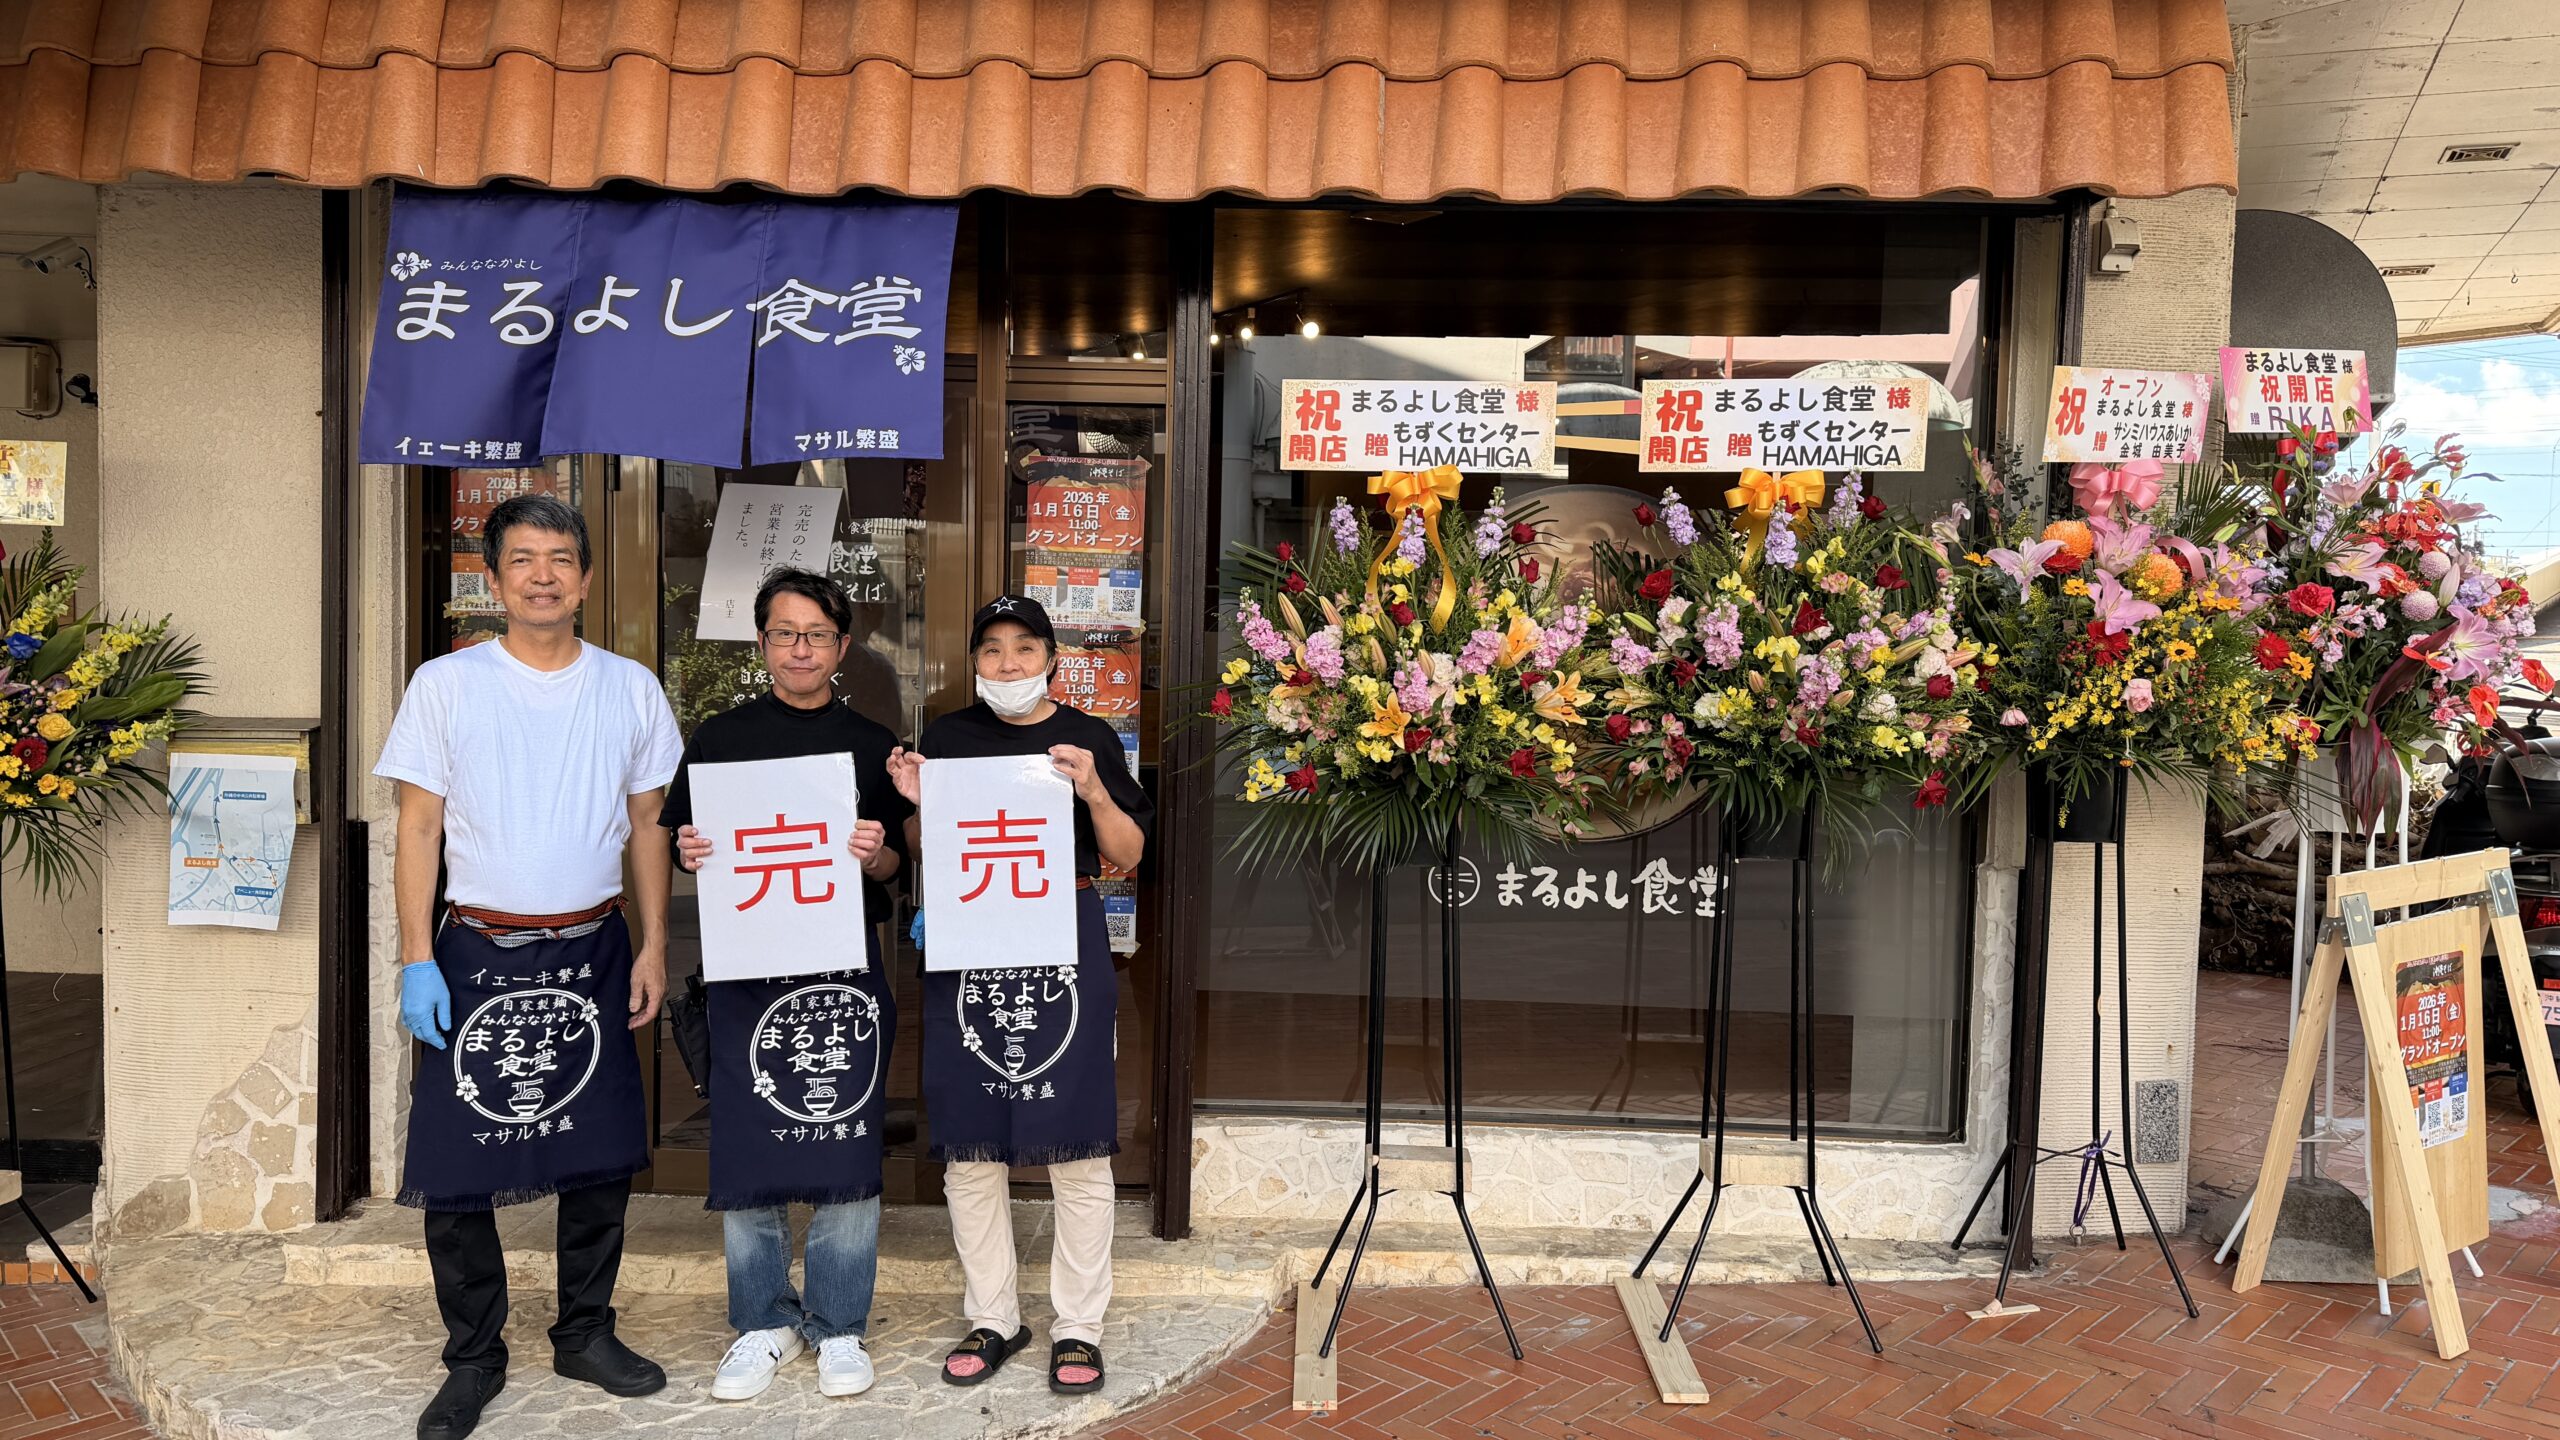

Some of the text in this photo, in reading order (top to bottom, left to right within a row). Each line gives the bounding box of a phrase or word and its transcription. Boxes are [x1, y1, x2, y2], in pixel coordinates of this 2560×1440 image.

[440, 256, 543, 273] みんななかよし
[395, 274, 923, 347] まるよし食堂
[2244, 351, 2354, 374] まるよし食堂 様
[2100, 375, 2164, 398] オープン
[2259, 374, 2335, 404] 祝開店
[1295, 389, 1342, 432] 祝
[1351, 388, 1540, 414] まるよし食堂 様
[1656, 389, 1703, 432] 祝
[1714, 388, 1912, 413] まるよし食堂 様
[2054, 386, 2087, 436] 祝
[2096, 398, 2194, 418] まるよし食堂 様
[2268, 405, 2336, 431] RIKA
[794, 428, 899, 453] マサル繁盛
[1393, 422, 1540, 444] もずくセンター
[1757, 420, 1912, 443] もずくセンター
[2092, 430, 2108, 452] 贈
[2113, 421, 2192, 442] サシミハウスあいか
[1289, 434, 1347, 464] 開店
[1364, 433, 1388, 457] 贈
[1398, 444, 1533, 468] HAMAHIGA
[1646, 434, 1709, 464] 開店
[1727, 433, 1752, 458] 贈
[1762, 444, 1902, 467] HAMAHIGA
[2119, 442, 2186, 459] 金城 由美子
[452, 515, 489, 531] グラ
[736, 502, 755, 548] ました。
[789, 503, 813, 574] 完売のた
[1028, 529, 1142, 547] グランドオープン
[830, 540, 878, 575] 食堂
[733, 809, 1050, 912] 完 売
[1496, 857, 1729, 918] まるよし食堂
[969, 966, 1057, 981] みんななかよし
[502, 995, 568, 1013] 自家製麺
[789, 991, 852, 1011] 自家製麺
[965, 980, 1064, 1006] まるよし
[480, 1010, 580, 1026] みんななかよし
[772, 1005, 866, 1025] みんななかよし
[988, 1006, 1039, 1033] 食堂
[465, 1023, 585, 1053] まるよし
[760, 1019, 874, 1050] まるよし
[786, 1046, 852, 1073] 食堂
[2400, 1033, 2466, 1062] グランドオープン
[493, 1048, 558, 1078] 食堂
[472, 1115, 574, 1145] マサル繁盛
[770, 1119, 868, 1143] マサル繁盛
[1057, 1351, 1090, 1364] PUMA
